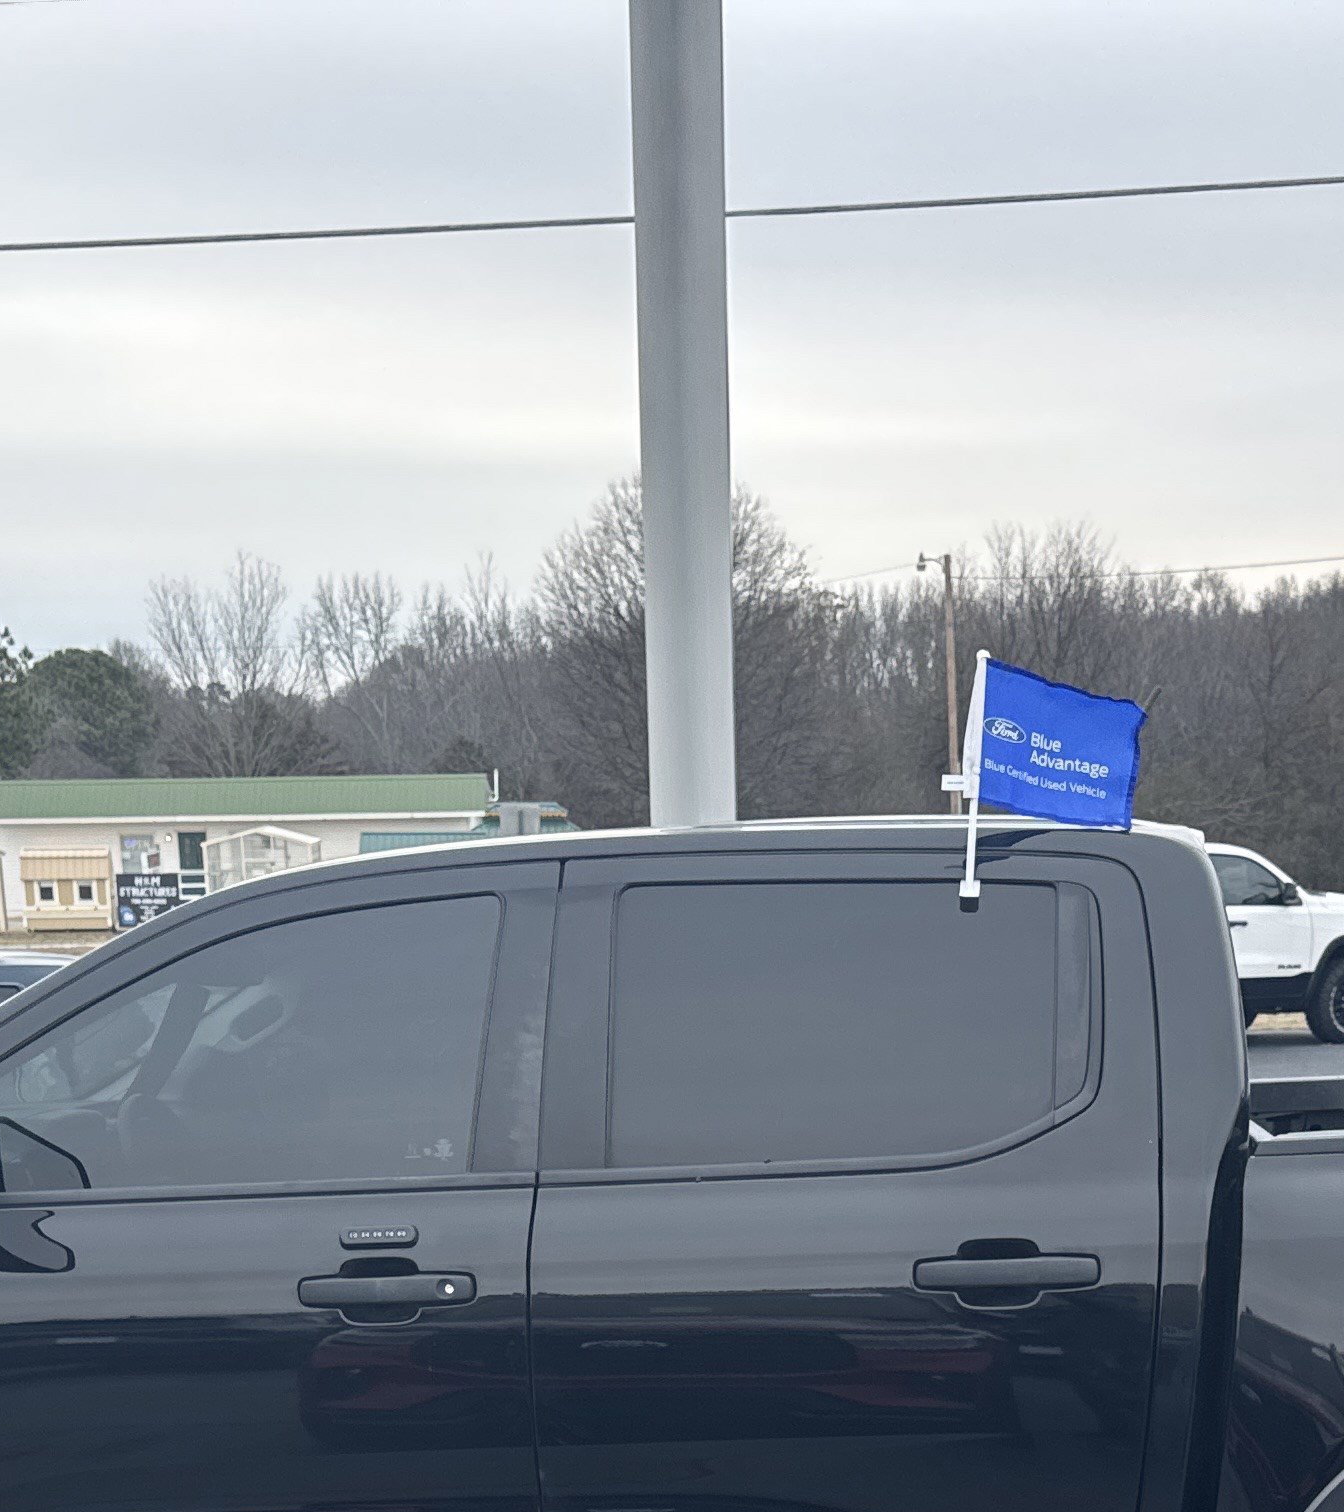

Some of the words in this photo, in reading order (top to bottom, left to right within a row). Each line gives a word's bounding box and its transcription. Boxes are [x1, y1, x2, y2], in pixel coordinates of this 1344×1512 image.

[992, 720, 1020, 741] Ford
[1030, 732, 1062, 753] Blue
[1030, 750, 1110, 778] Advantage
[984, 758, 1006, 774] Blue
[1006, 765, 1039, 786] Certified
[1040, 777, 1067, 792] Used
[1069, 782, 1108, 800] Vehicle
